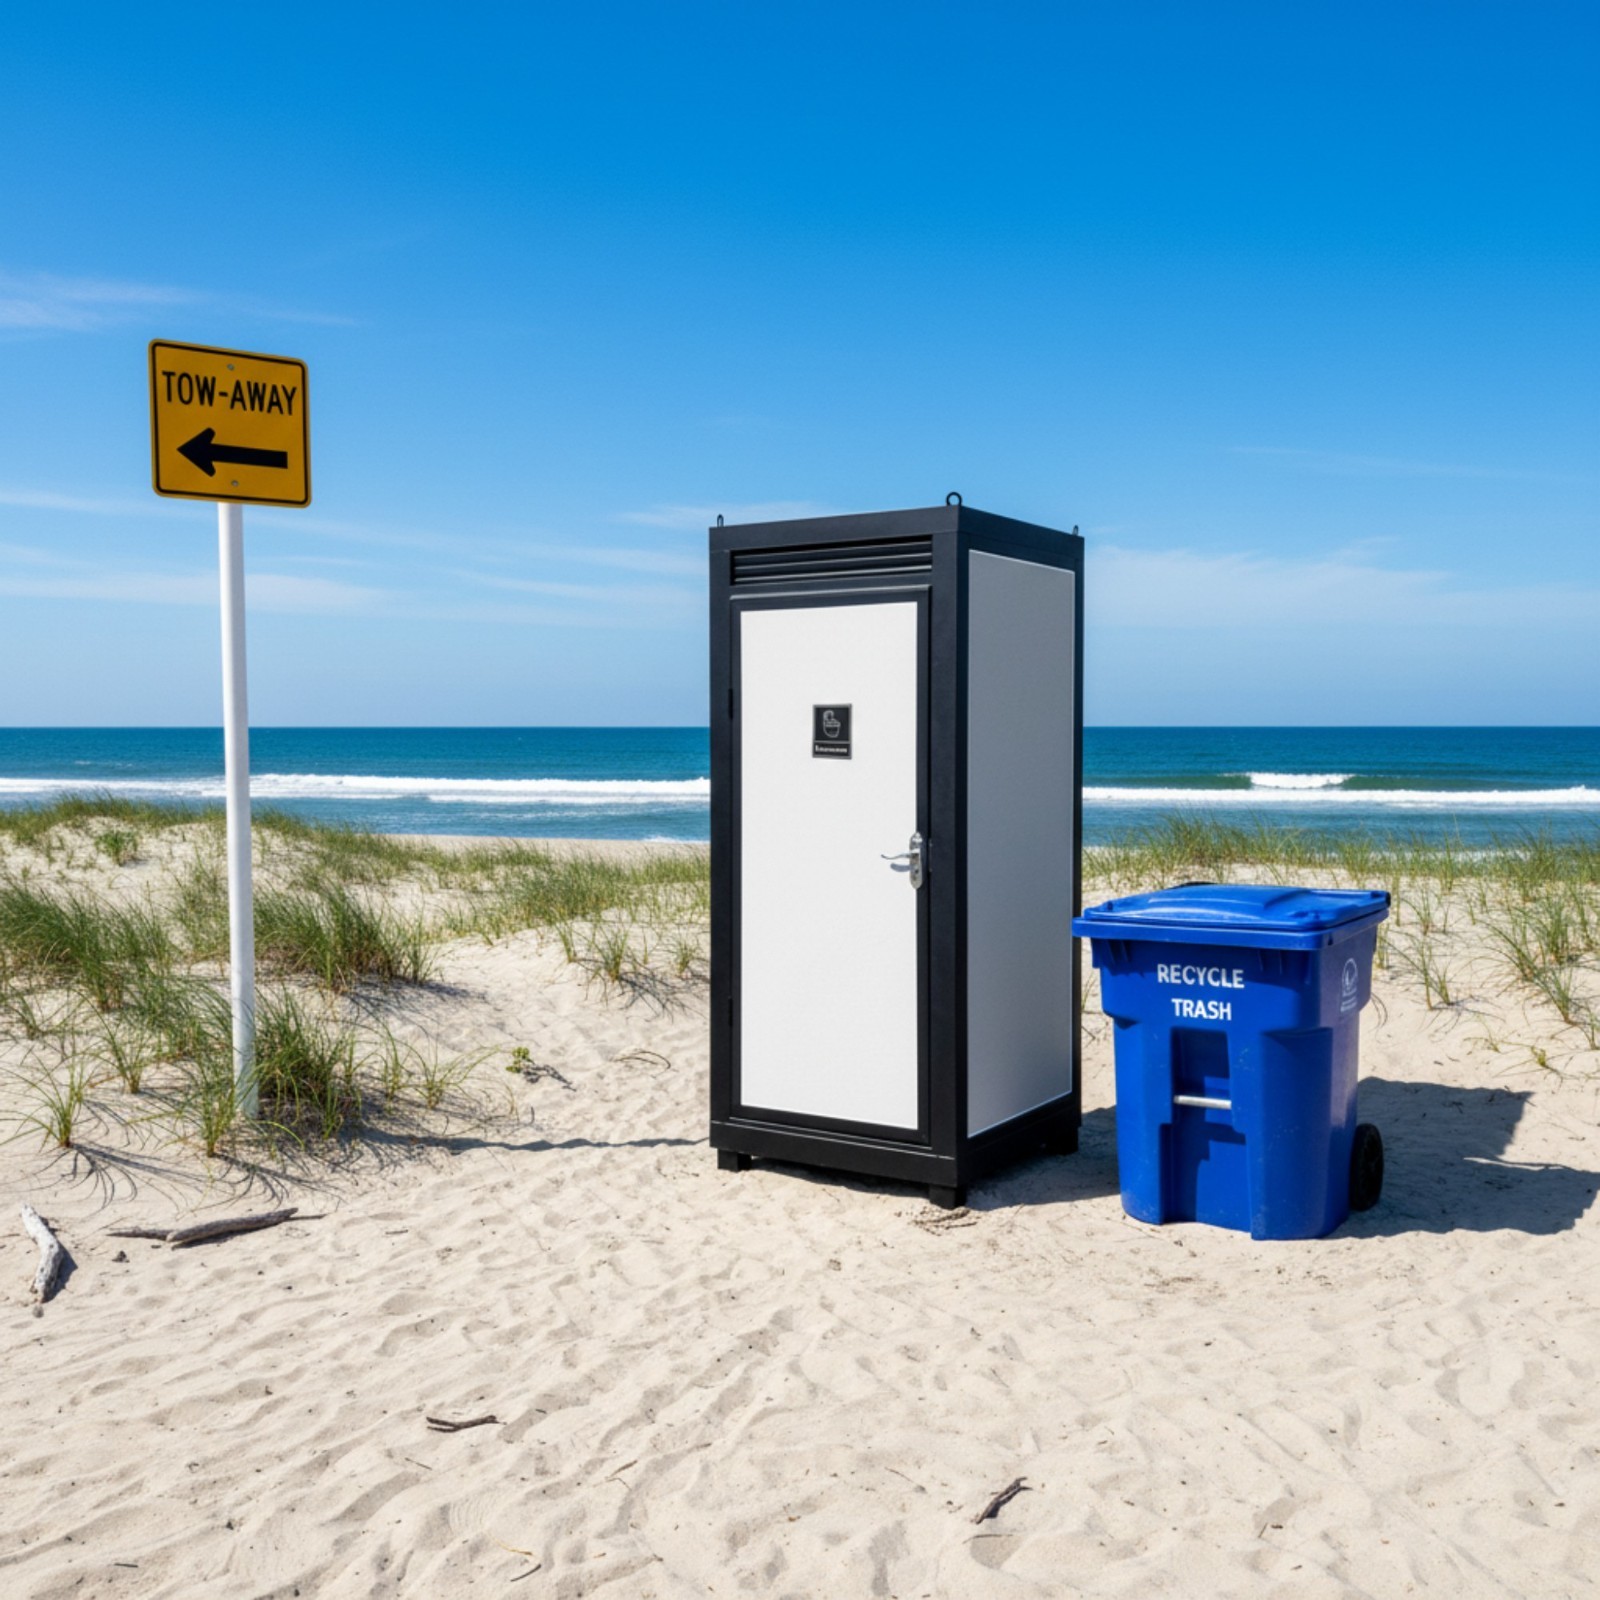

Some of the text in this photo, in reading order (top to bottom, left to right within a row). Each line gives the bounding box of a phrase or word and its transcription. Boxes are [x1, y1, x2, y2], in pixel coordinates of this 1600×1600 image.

[162, 370, 297, 416] TOW-AWAY
[1157, 963, 1245, 988] RECYCLE
[1171, 998, 1232, 1021] TRASH
